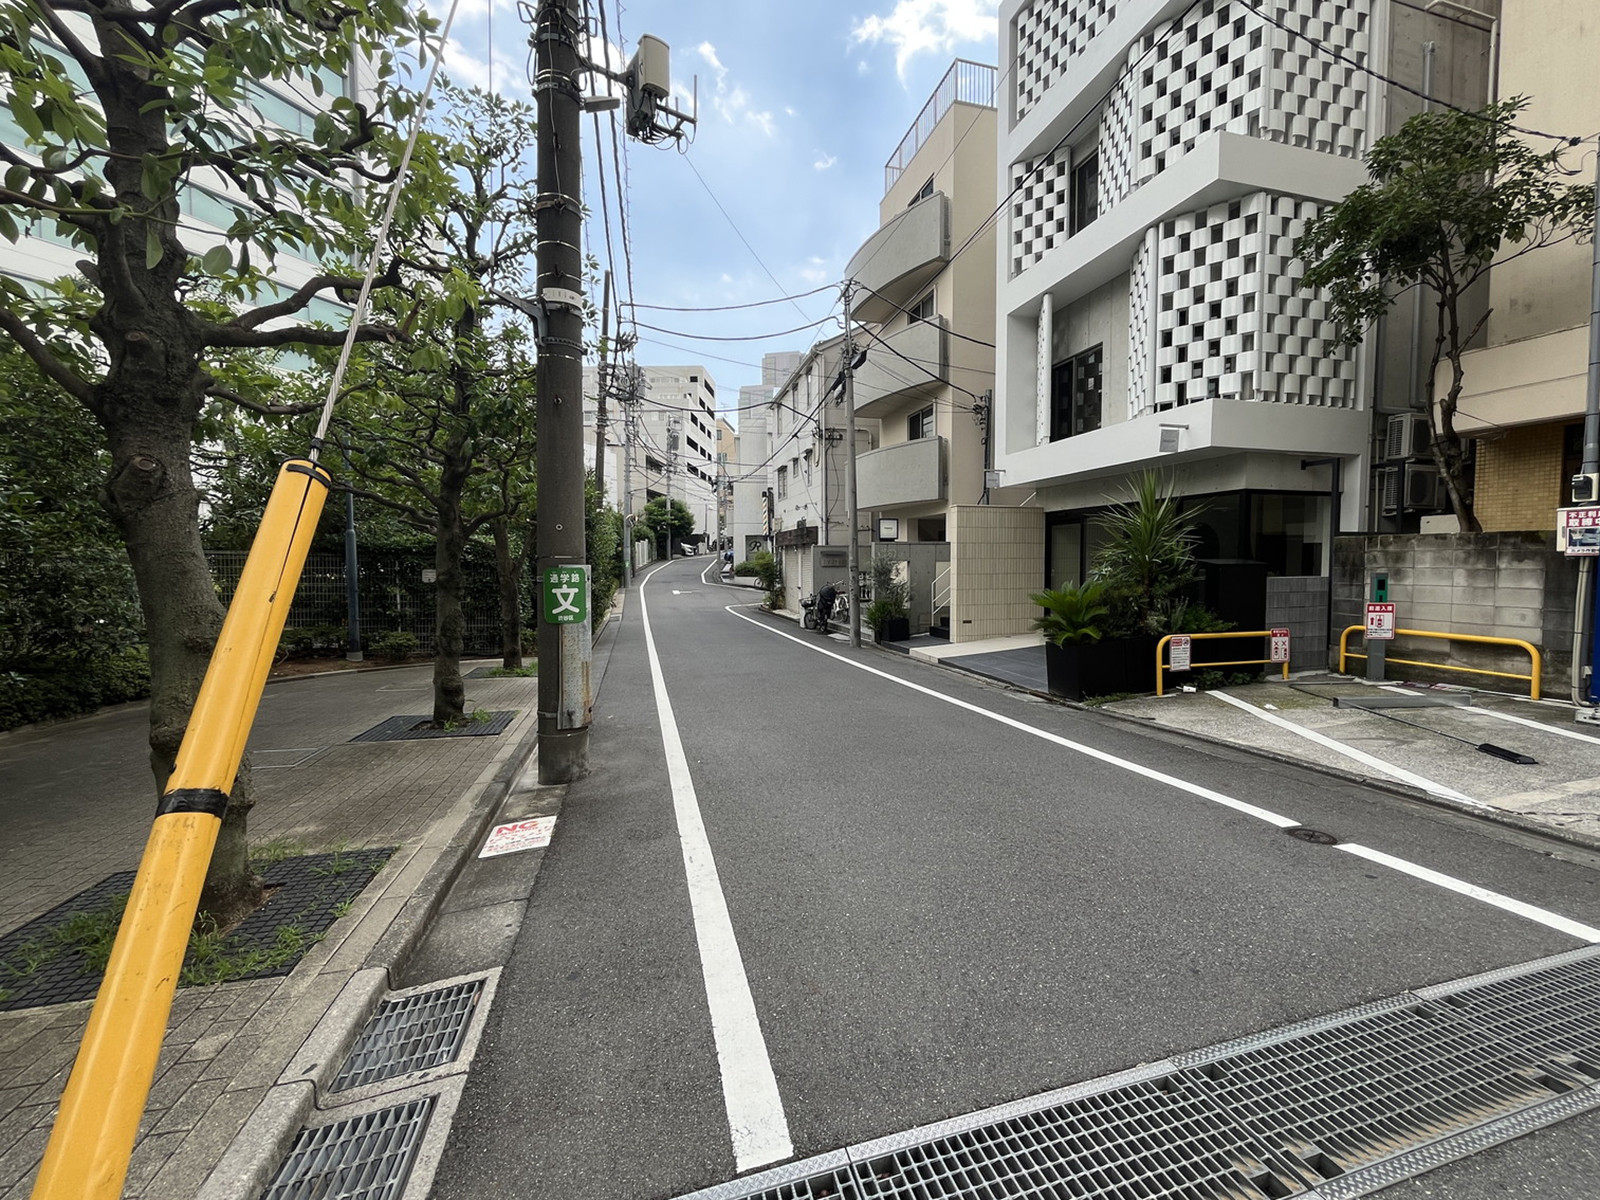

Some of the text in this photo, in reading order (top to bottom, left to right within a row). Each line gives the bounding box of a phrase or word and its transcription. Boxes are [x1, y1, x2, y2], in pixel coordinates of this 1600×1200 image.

[1568, 510, 1600, 519] 不正利
[549, 573, 580, 583] 通学路
[551, 584, 580, 615] 文
